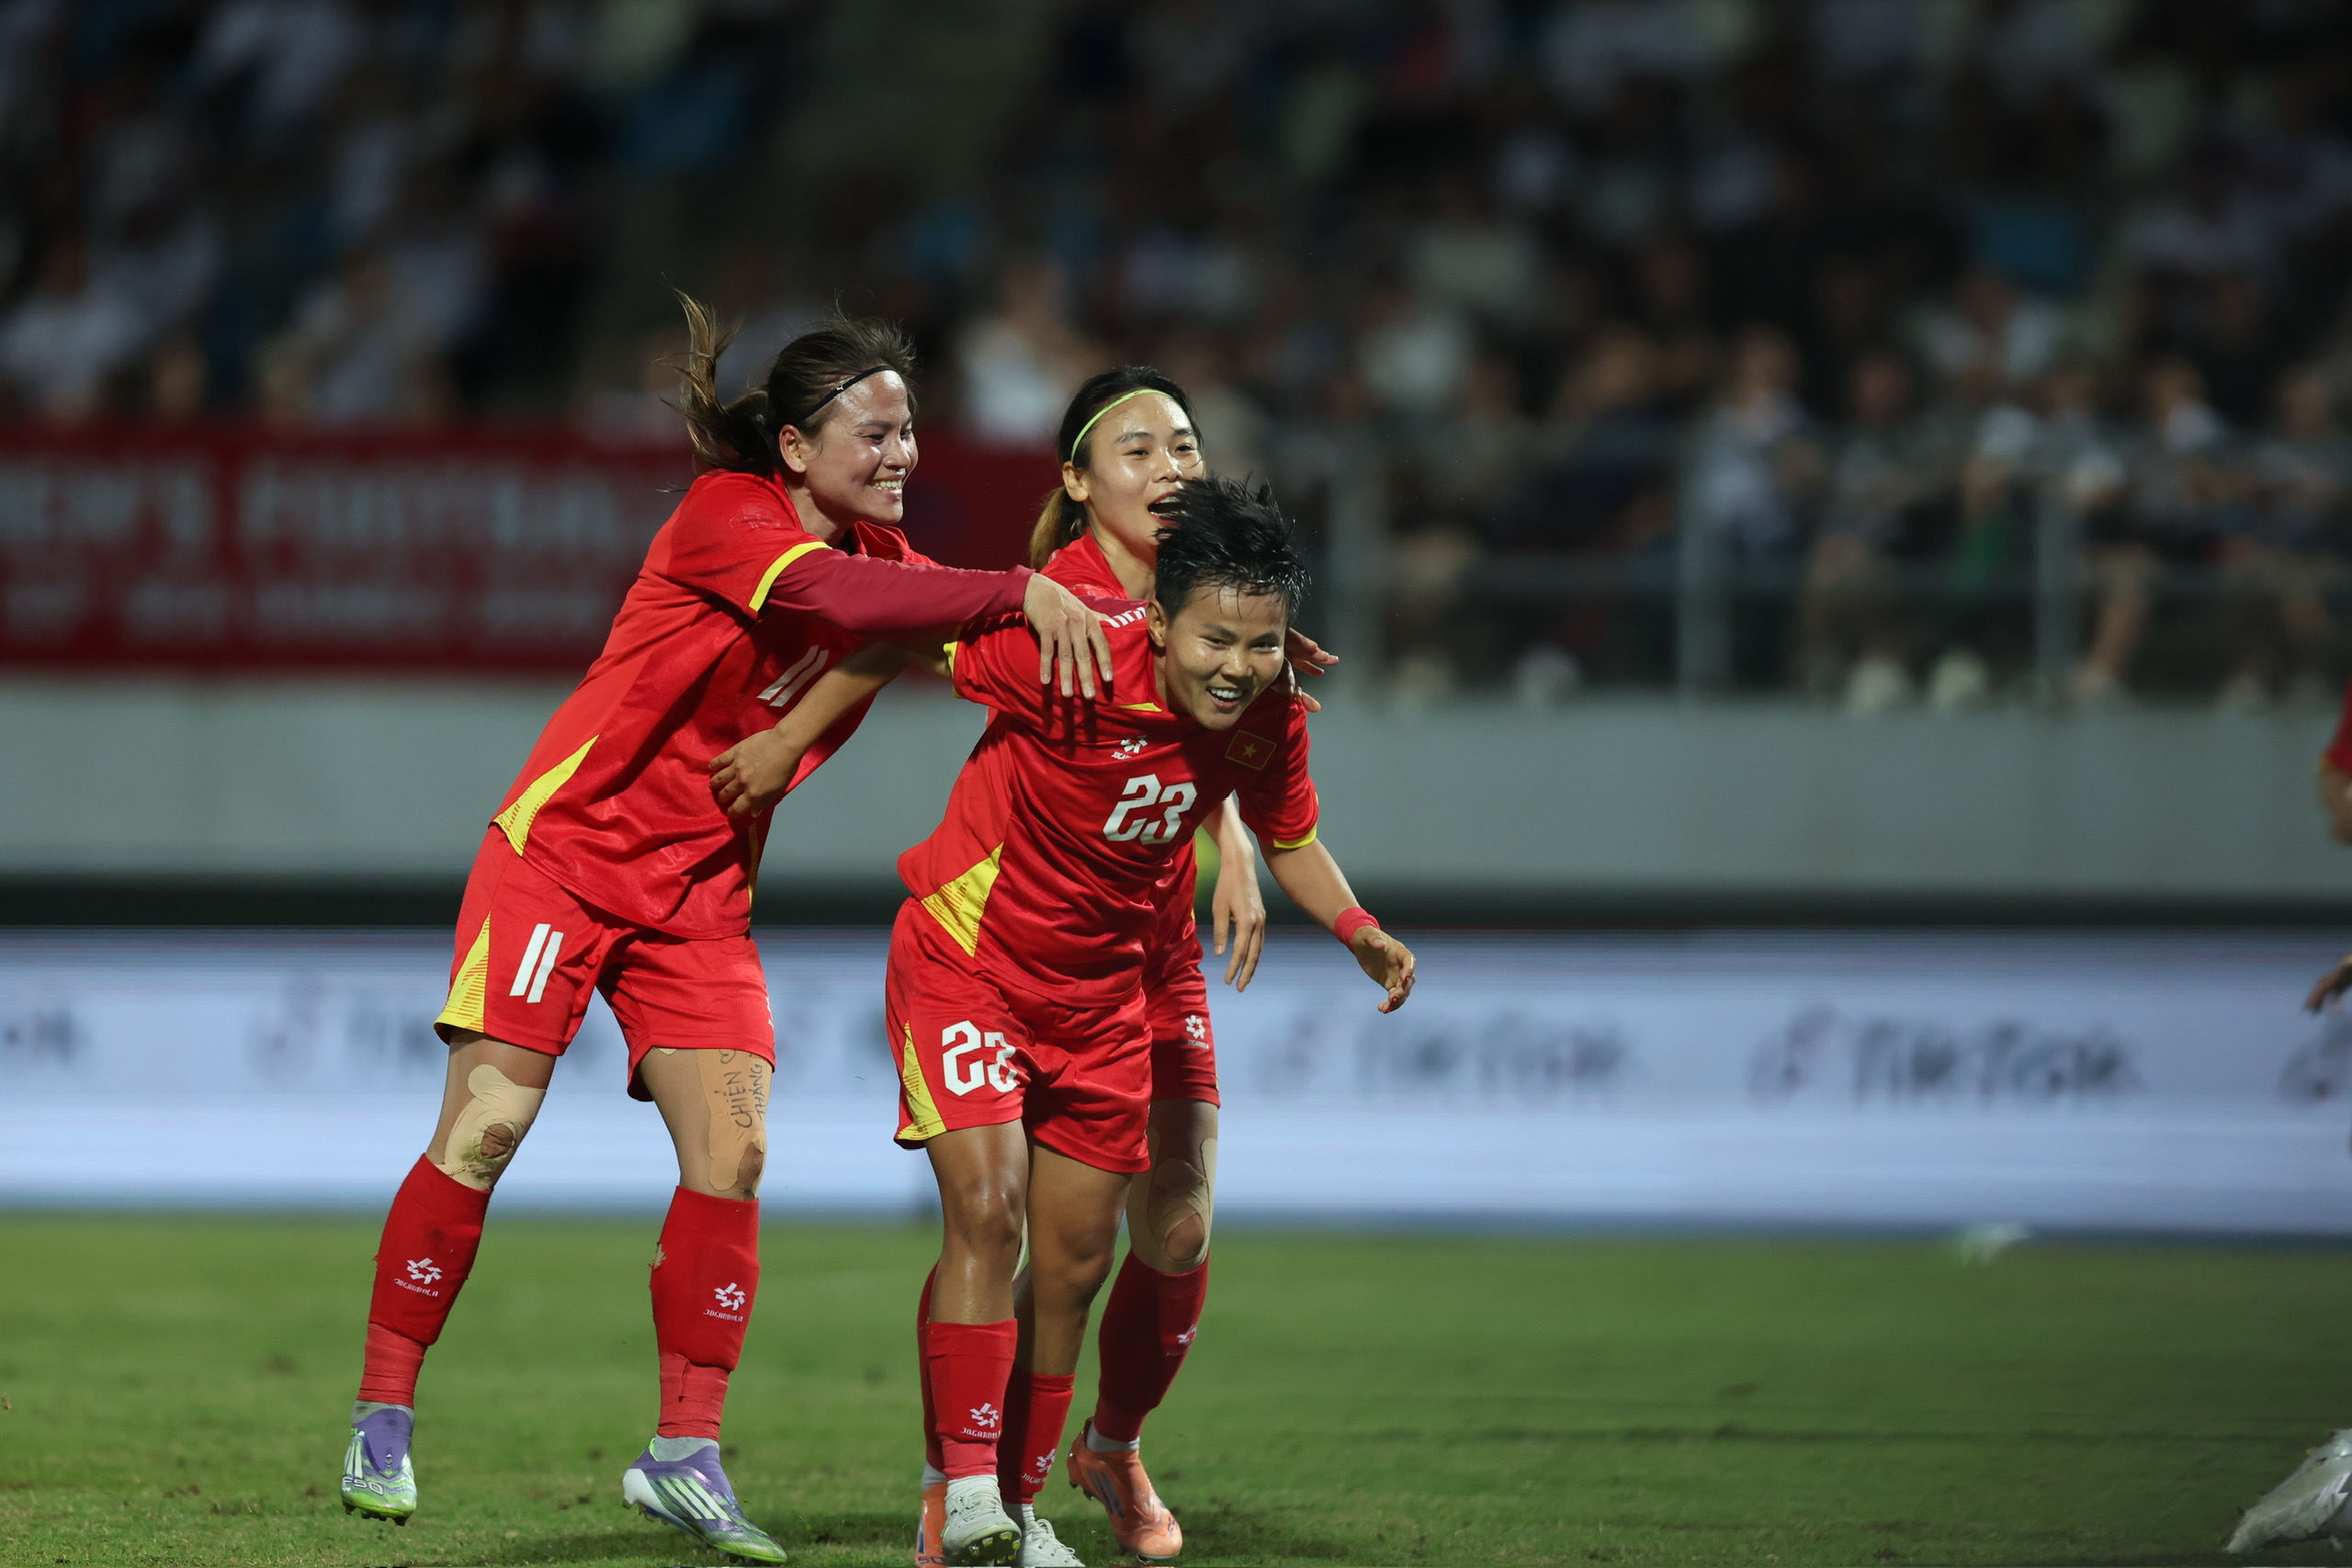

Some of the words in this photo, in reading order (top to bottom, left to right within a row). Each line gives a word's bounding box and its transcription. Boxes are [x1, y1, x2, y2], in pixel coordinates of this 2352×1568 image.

[756, 645, 829, 707] 11
[1102, 773, 1198, 845] 23
[509, 923, 564, 1003] 11
[942, 1020, 1018, 1097] 23
